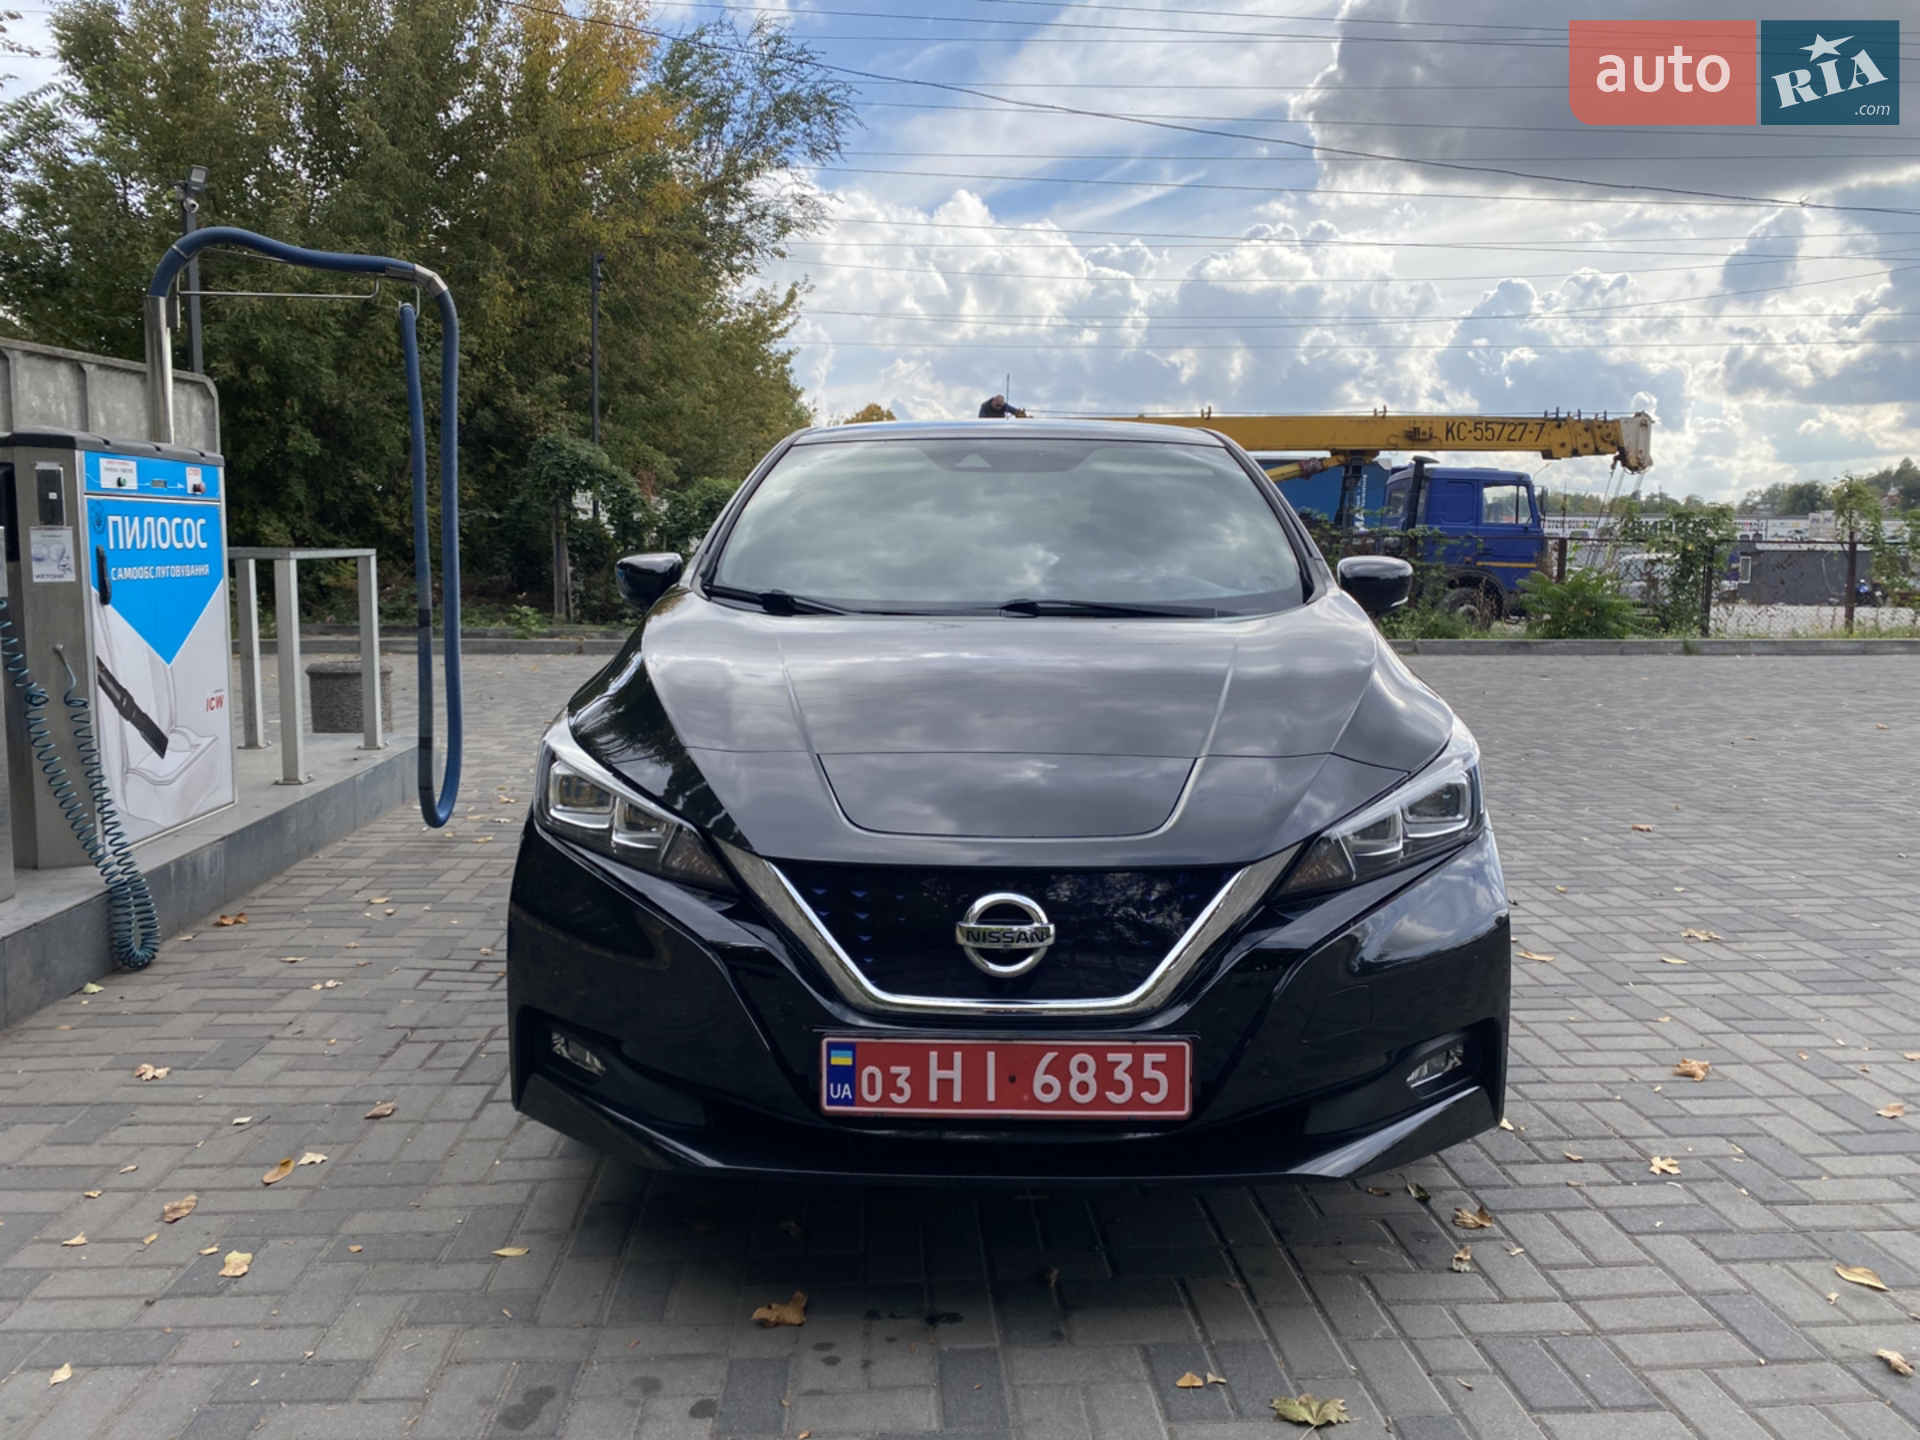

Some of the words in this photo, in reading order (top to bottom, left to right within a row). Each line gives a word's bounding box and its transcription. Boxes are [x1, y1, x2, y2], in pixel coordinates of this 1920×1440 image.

[107, 515, 208, 550] ПИЛОСОС
[111, 564, 210, 581] САМООБСЛУГОВУВАННЯ
[205, 694, 225, 712] ICW
[966, 930, 1046, 945] NISSAN
[861, 1065, 912, 1104] 03
[1033, 1052, 1169, 1105] 6835
[829, 1082, 853, 1100] UA
